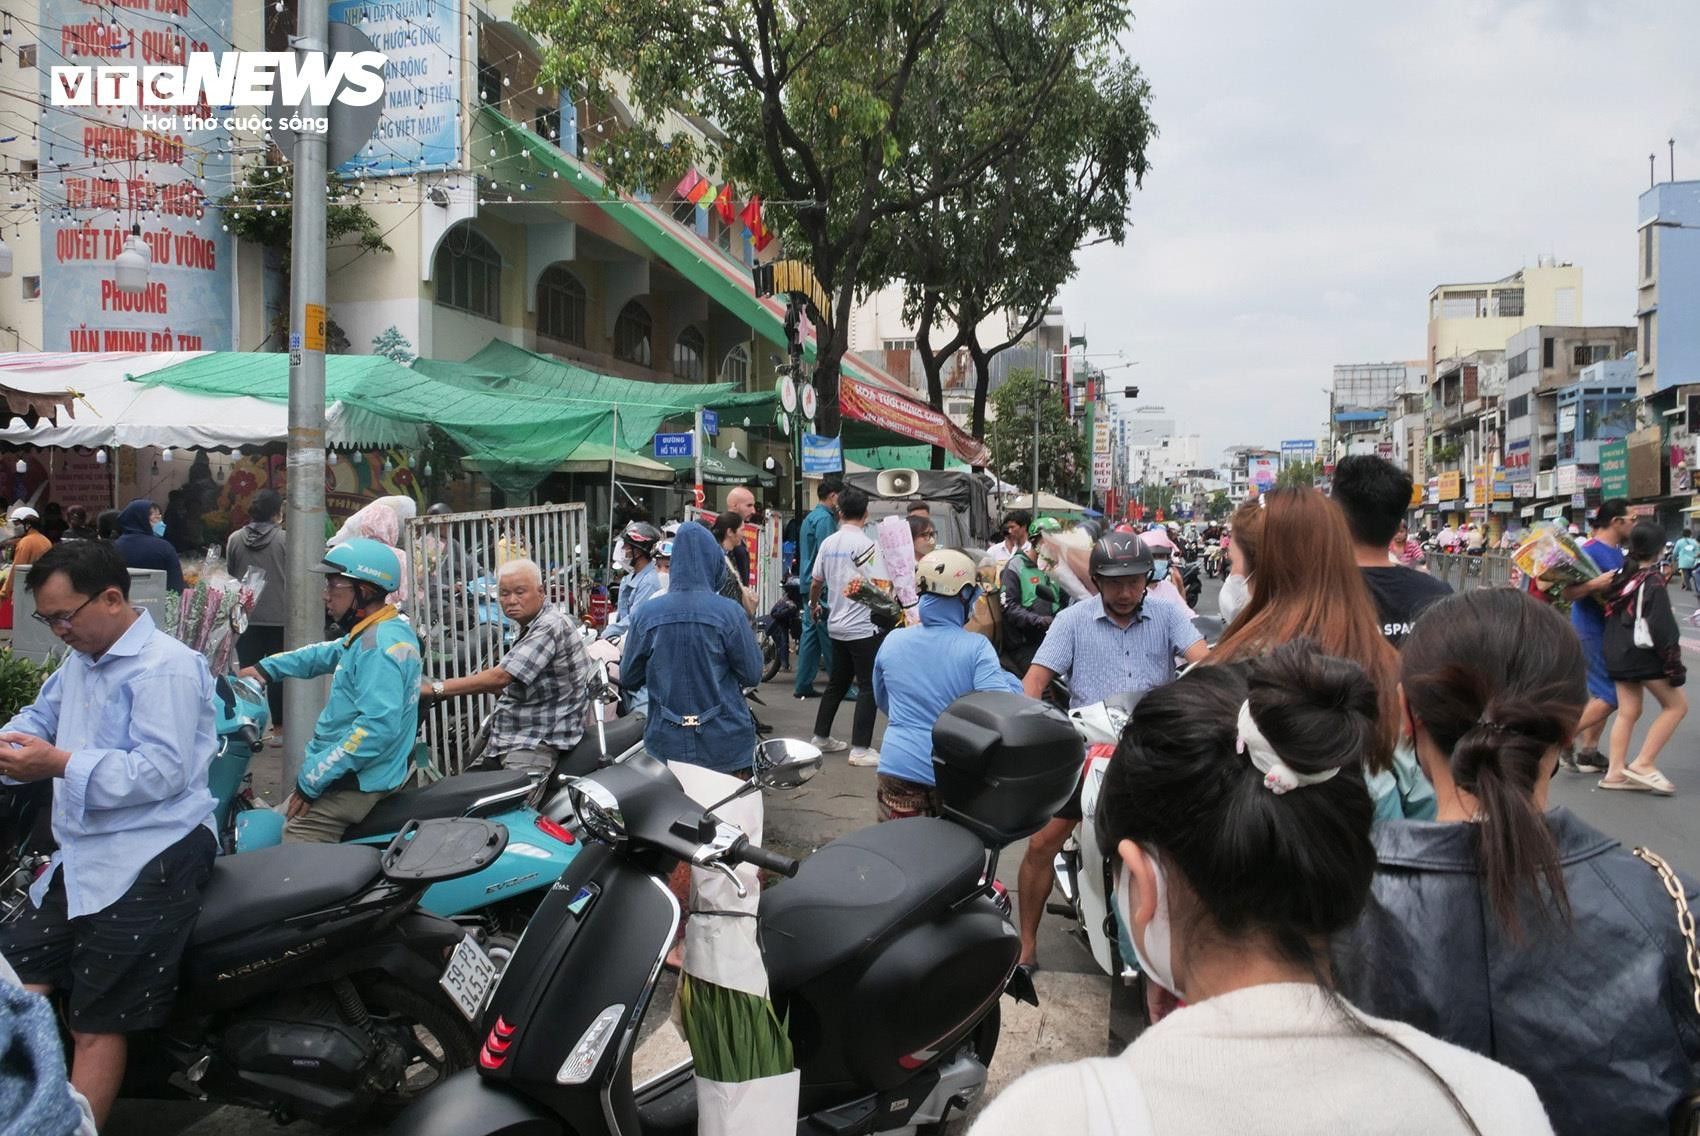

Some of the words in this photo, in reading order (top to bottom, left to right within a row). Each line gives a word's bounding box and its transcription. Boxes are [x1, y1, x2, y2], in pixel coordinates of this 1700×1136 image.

[389, 90, 412, 109] NAM
[84, 127, 138, 161] PHONG
[56, 219, 100, 263] QUYẾT
[174, 231, 216, 271] VỮNG
[662, 435, 685, 443] ĐƯỜNG
[449, 942, 477, 991] 59-P3
[460, 957, 494, 1014] 345.34
